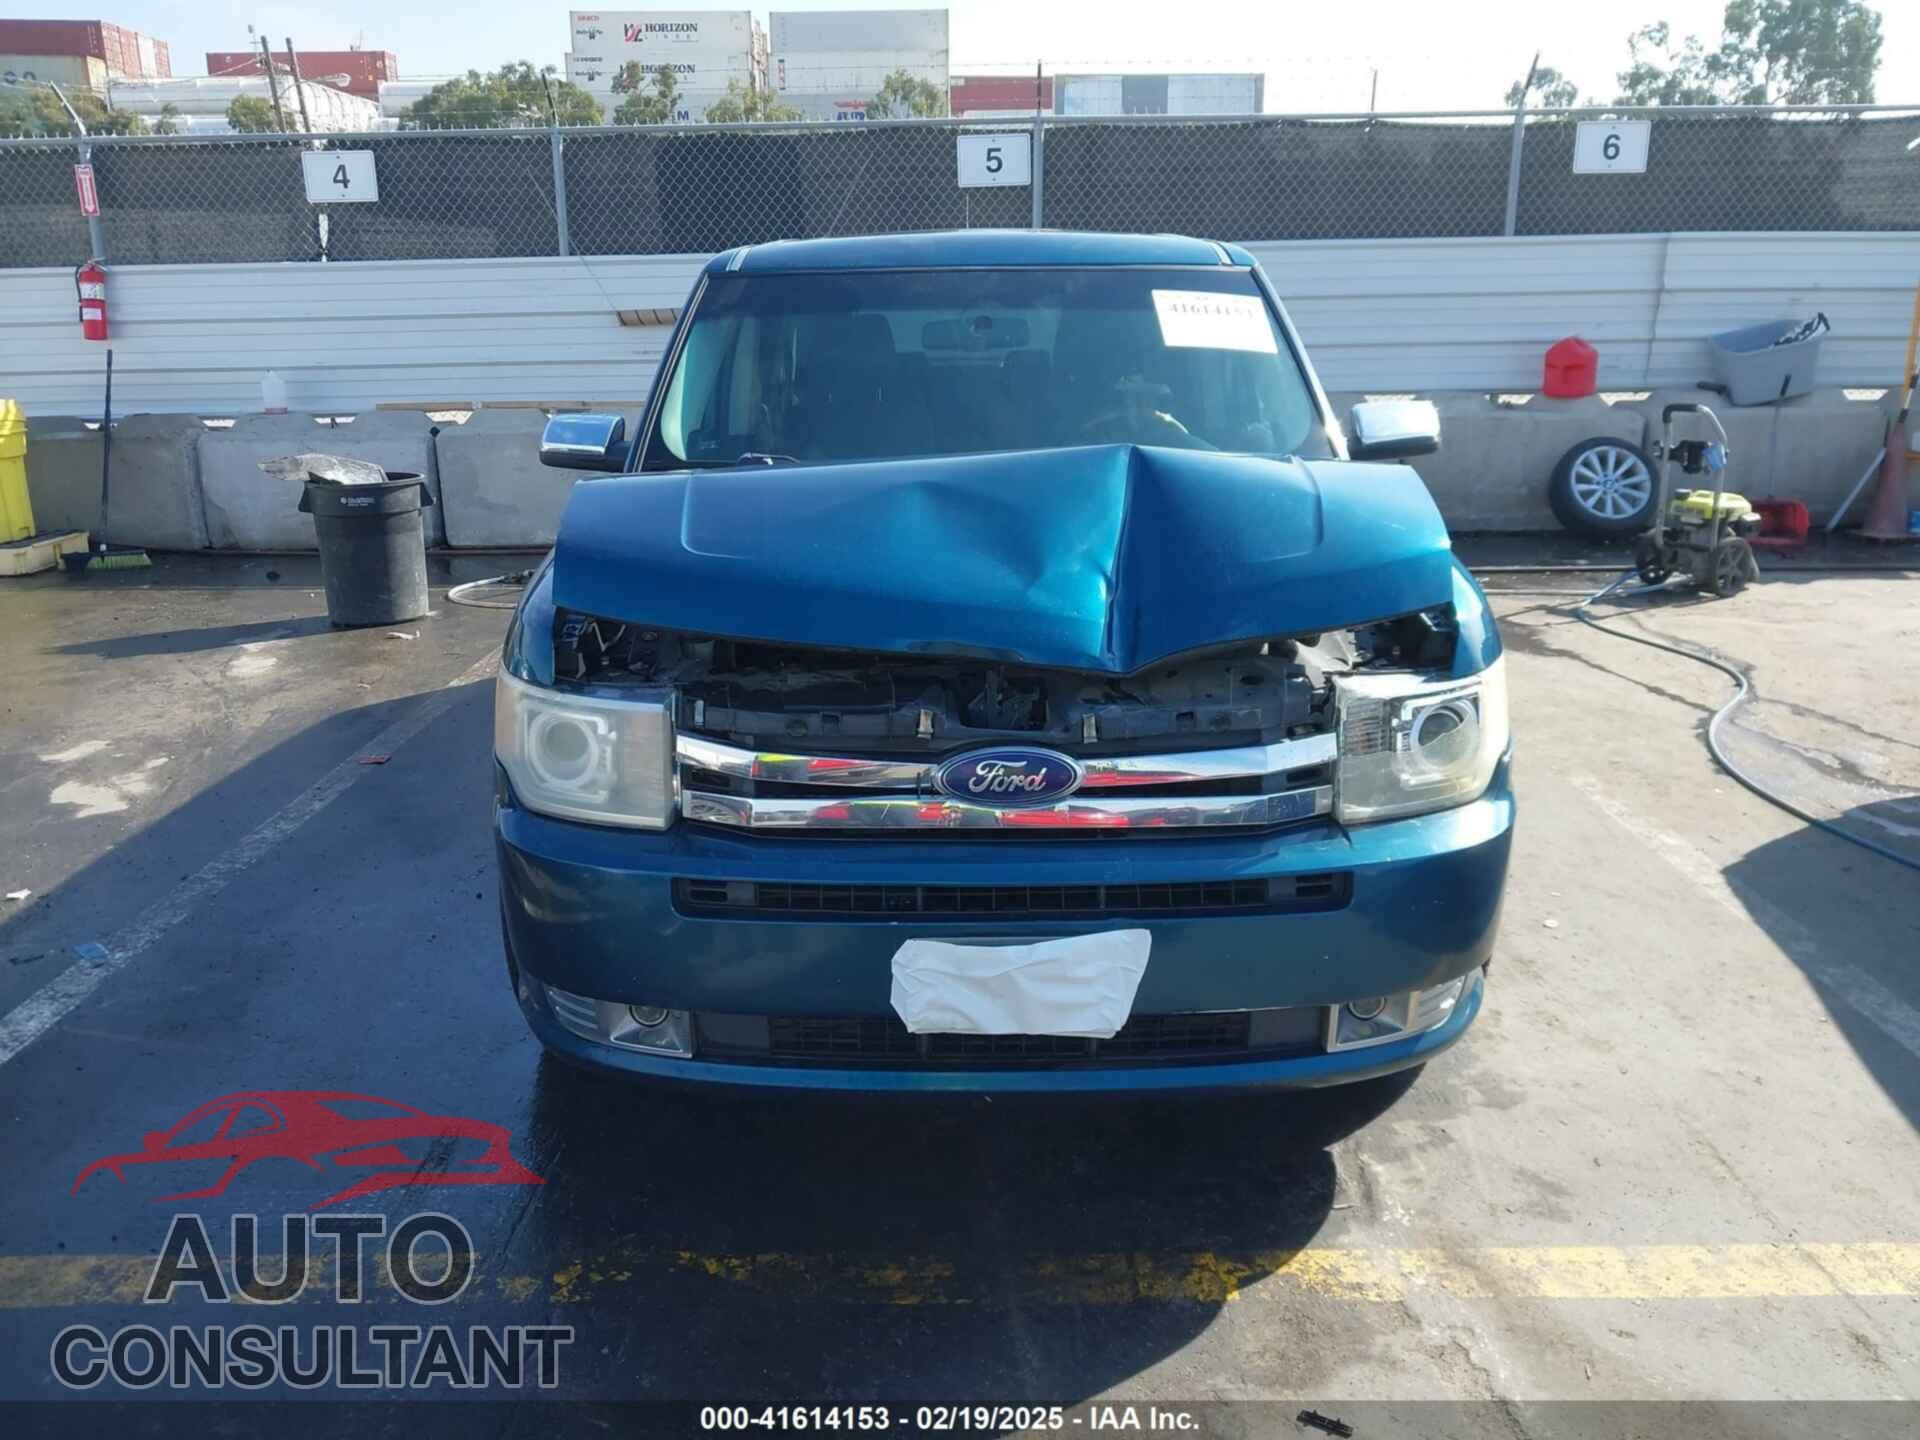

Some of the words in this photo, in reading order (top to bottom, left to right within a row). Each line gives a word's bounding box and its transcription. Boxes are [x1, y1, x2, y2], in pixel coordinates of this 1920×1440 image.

[644, 23, 698, 32] HORIZON
[640, 64, 696, 73] HOZON
[1602, 134, 1621, 160] 6
[985, 148, 1004, 174] 5
[332, 163, 351, 189] 4
[968, 760, 1048, 793] Ford
